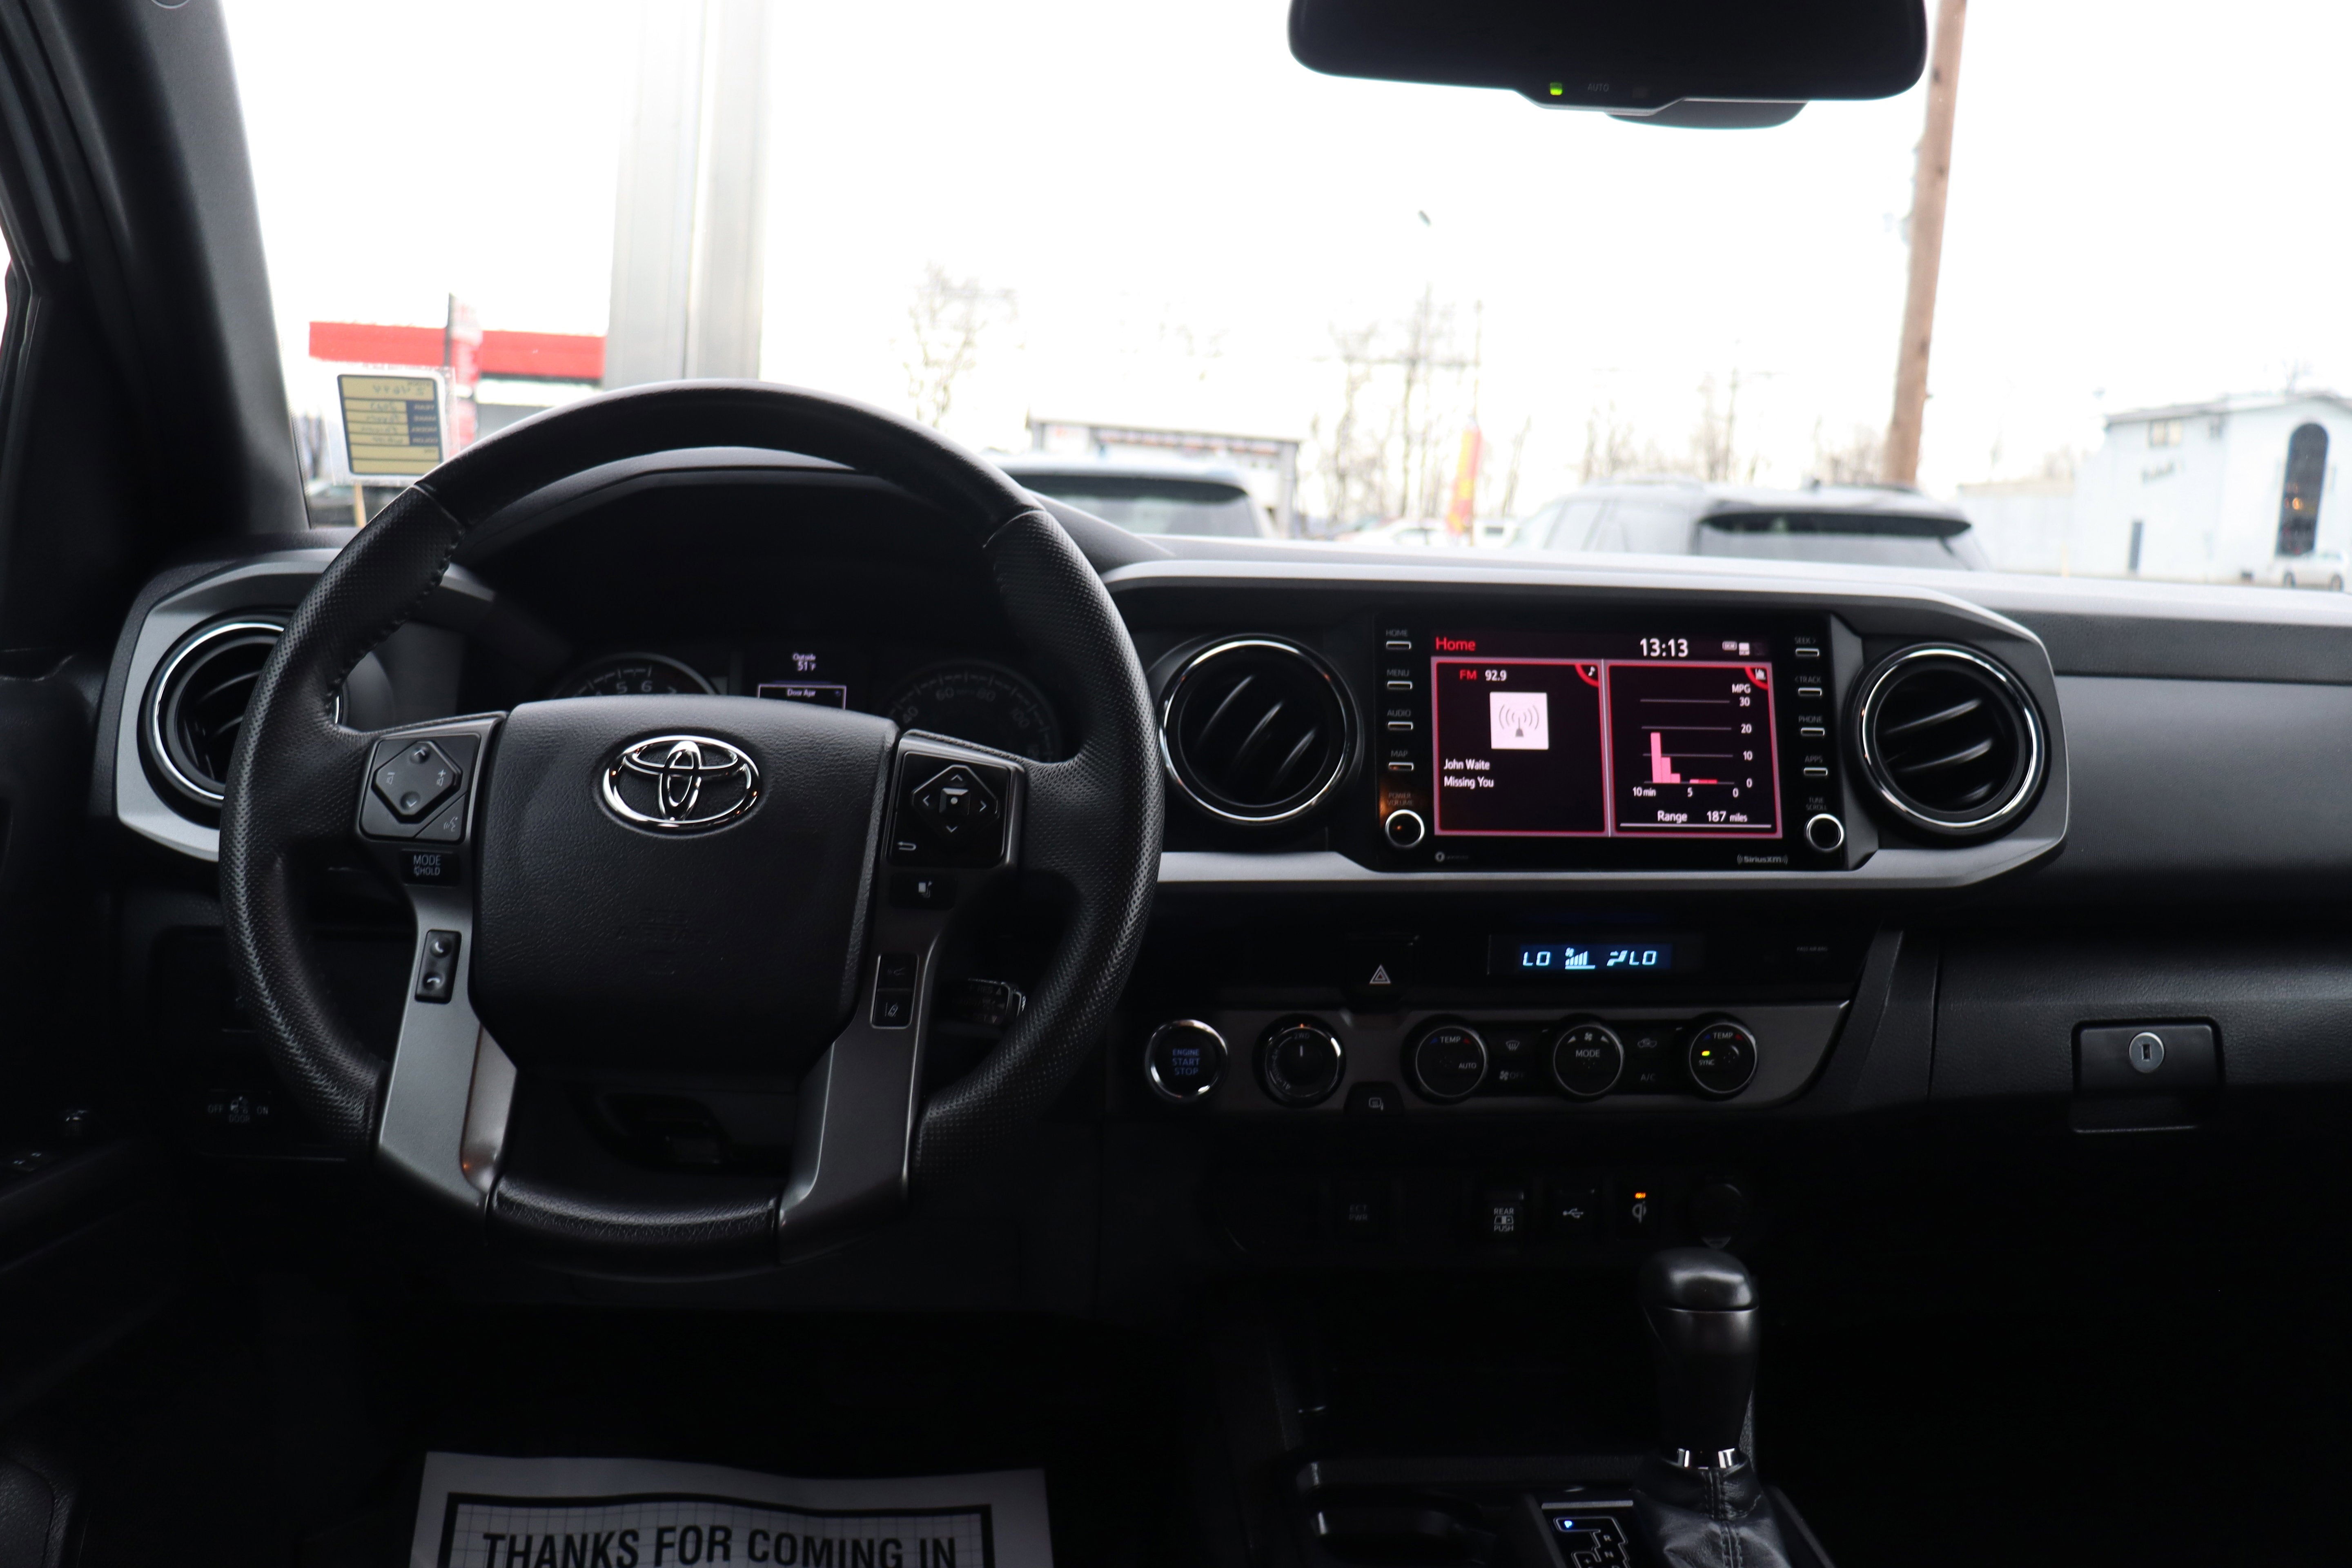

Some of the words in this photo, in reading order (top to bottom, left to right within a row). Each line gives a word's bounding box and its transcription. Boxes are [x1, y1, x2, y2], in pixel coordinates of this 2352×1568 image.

[1587, 83, 1609, 92] AUTO
[1436, 637, 1476, 651] Home
[1640, 638, 1688, 657] 13:13
[1460, 670, 1477, 680] FM
[1485, 670, 1507, 681] 92.9
[616, 681, 628, 694] 5
[641, 680, 653, 693] 6
[1732, 684, 1751, 693] MPG
[935, 686, 955, 701] 60
[977, 687, 996, 702] 80
[1740, 697, 1750, 706] 30
[1741, 724, 1752, 733] 20
[1743, 751, 1753, 760] 10
[1444, 759, 1464, 770] John
[1465, 759, 1490, 771] Waite
[1444, 776, 1475, 789] Missing
[1477, 776, 1494, 788] You
[1746, 778, 1753, 788] 0
[1633, 786, 1642, 797] 10
[1643, 788, 1656, 797] min
[1687, 787, 1693, 797] 5
[1732, 788, 1739, 797] 0
[1657, 810, 1688, 824] Range
[1706, 811, 1726, 822] 187
[1729, 813, 1748, 822] miles
[413, 854, 441, 866] MODE
[420, 866, 441, 876] HOLD
[1522, 951, 1551, 967] LO
[1629, 950, 1657, 966] LO
[1440, 1036, 1461, 1044] TEMP
[1172, 1047, 1200, 1056] ENGINE
[1575, 1049, 1601, 1058] MODE
[1172, 1057, 1200, 1066] START
[1174, 1067, 1199, 1076] STOP
[1640, 1072, 1656, 1081] A/C
[207, 1104, 223, 1114] OFF
[256, 1105, 268, 1115] ON
[1350, 1204, 1368, 1213] ECT
[1603, 1534, 1613, 1542] R
[483, 1529, 639, 1568] THANKS
[654, 1525, 731, 1567] FOR
[747, 1529, 902, 1568] COMING
[920, 1537, 956, 1568] IN
